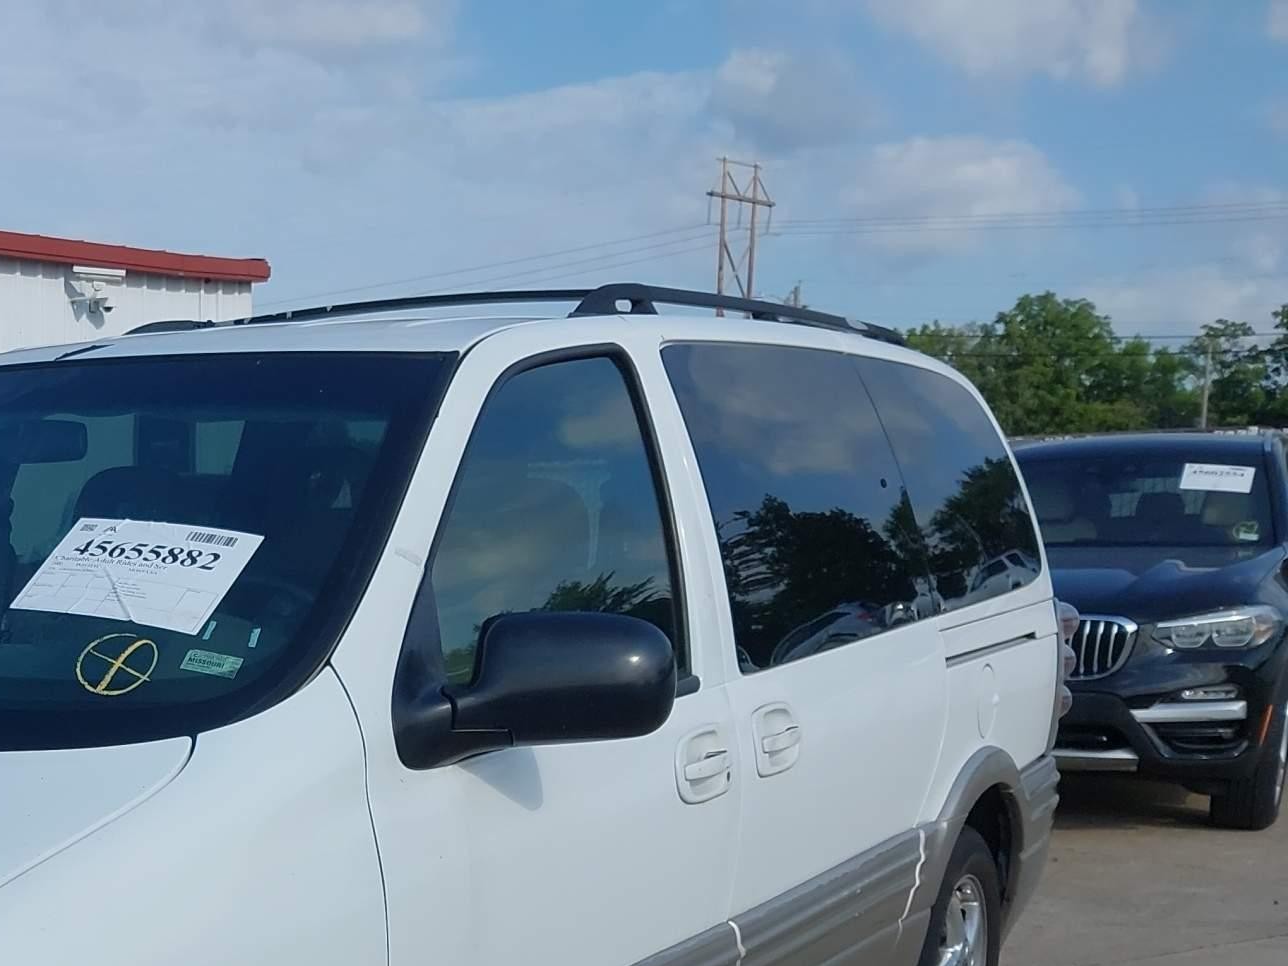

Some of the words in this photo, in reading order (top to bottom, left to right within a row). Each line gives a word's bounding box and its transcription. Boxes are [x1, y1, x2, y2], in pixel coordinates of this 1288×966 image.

[73, 539, 221, 571] 45655882
[116, 559, 137, 567] Rides
[138, 561, 153, 569] and
[187, 656, 226, 669] MISSOURI
